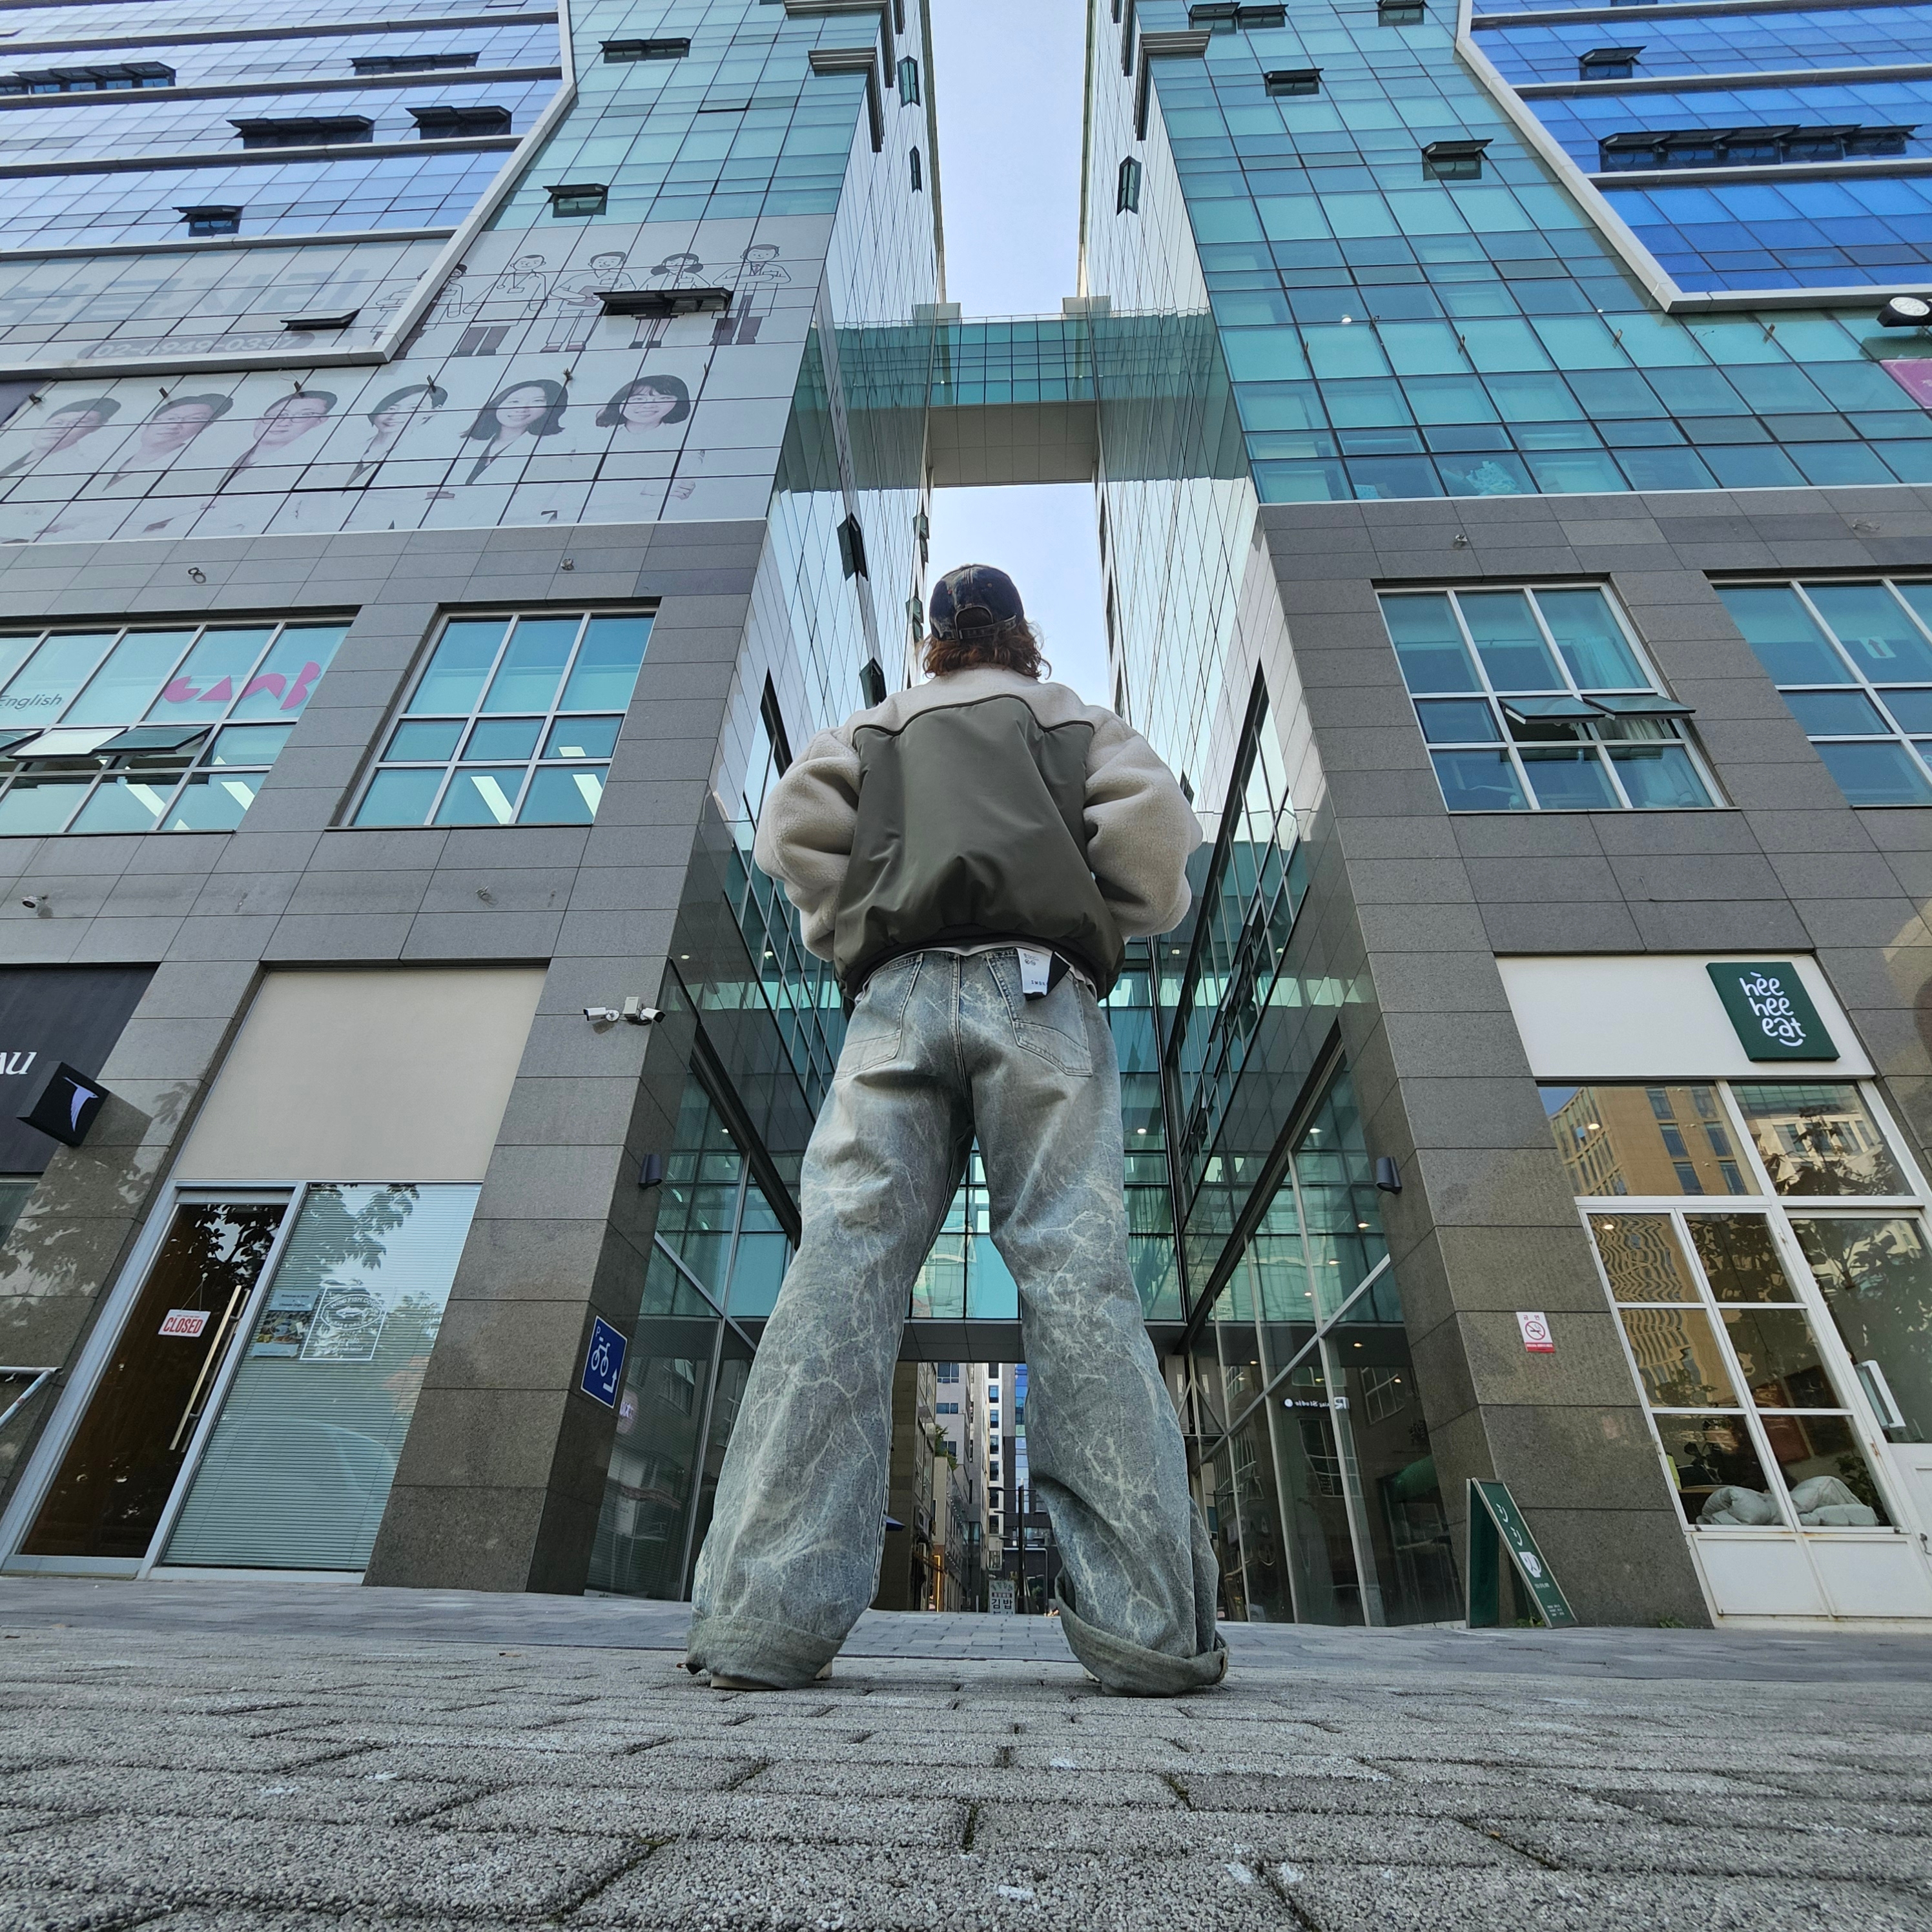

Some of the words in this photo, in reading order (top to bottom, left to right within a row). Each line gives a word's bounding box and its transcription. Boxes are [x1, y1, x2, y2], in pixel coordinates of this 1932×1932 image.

[94, 336, 304, 356] 02-6949-0337
[1749, 997, 1794, 1016] hee
[1762, 1017, 1807, 1038] eat
[163, 1317, 204, 1334] CLOSED
[595, 1326, 601, 1337] P
[991, 1598, 1013, 1610] 김밥
